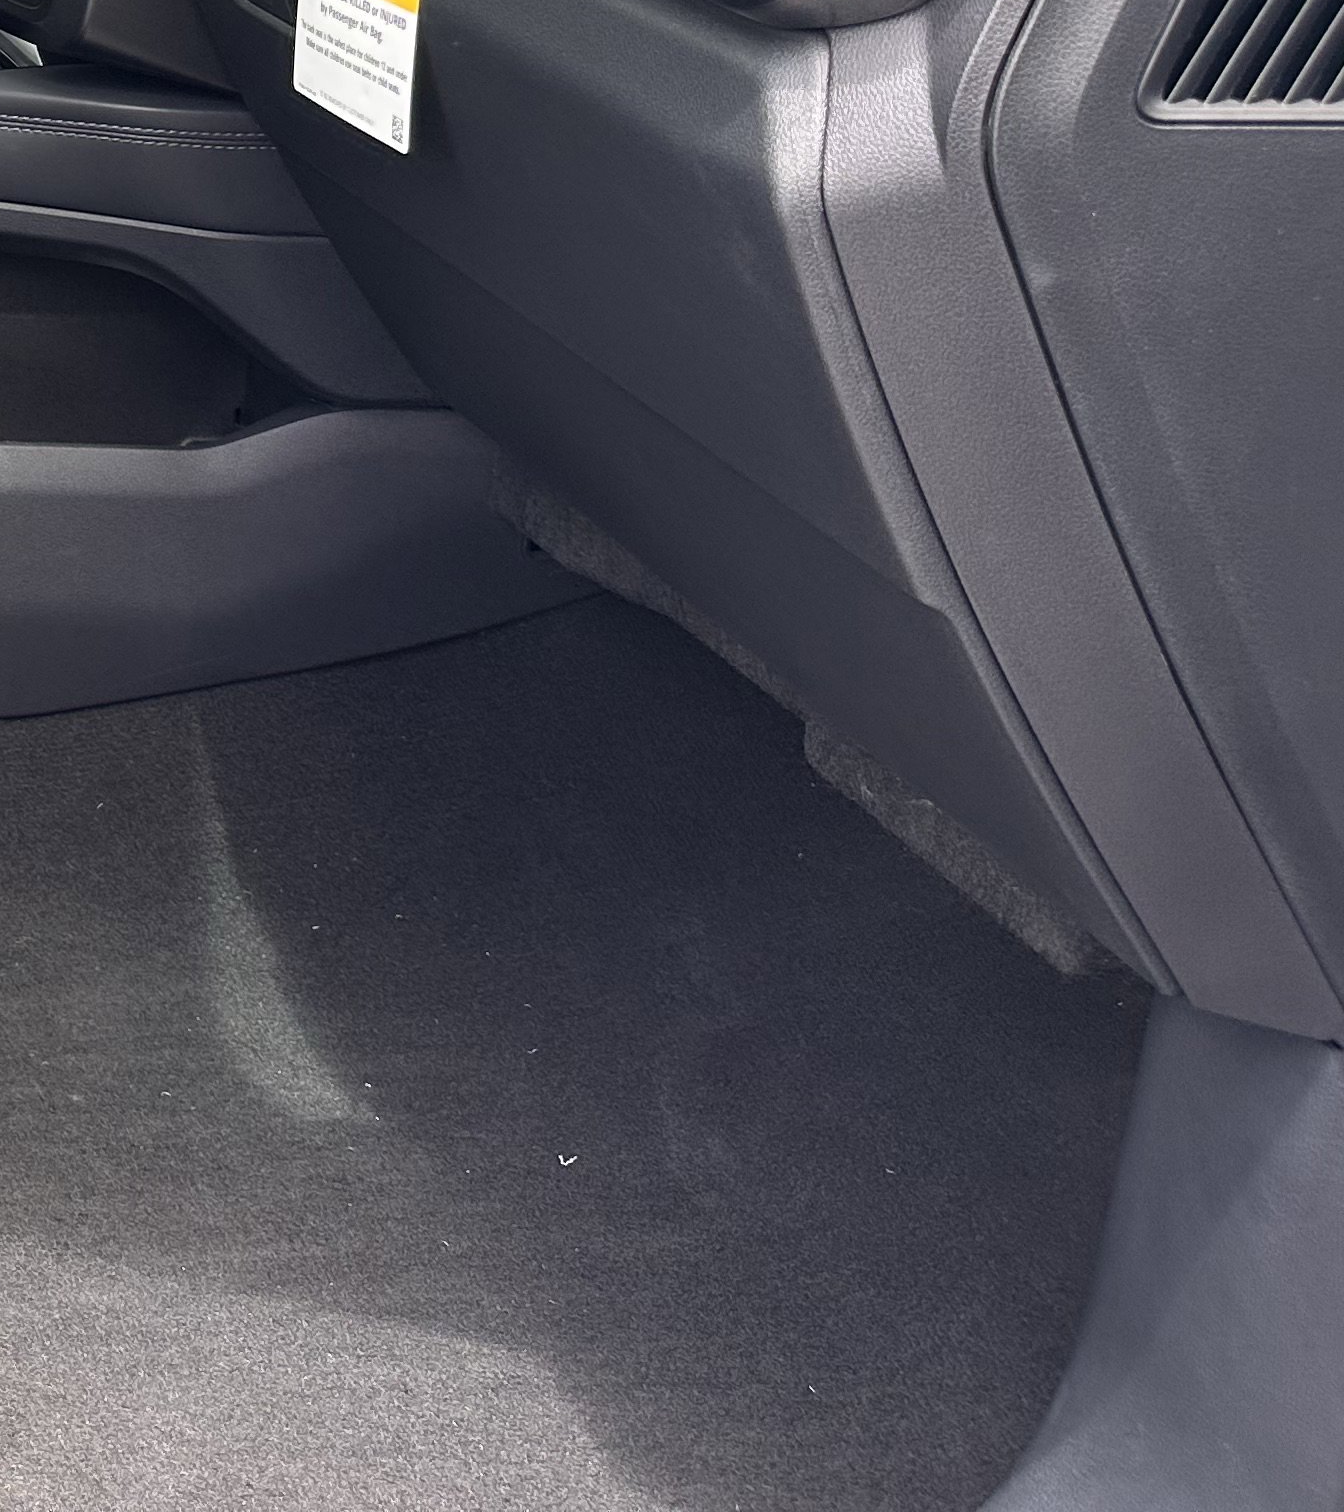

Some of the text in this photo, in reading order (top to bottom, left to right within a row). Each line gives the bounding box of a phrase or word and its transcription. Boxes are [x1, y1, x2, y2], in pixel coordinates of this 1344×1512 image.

[320, 0, 328, 16] by
[328, 5, 360, 29] Passenger
[359, 20, 368, 34] Air
[380, 8, 407, 30] INJURED
